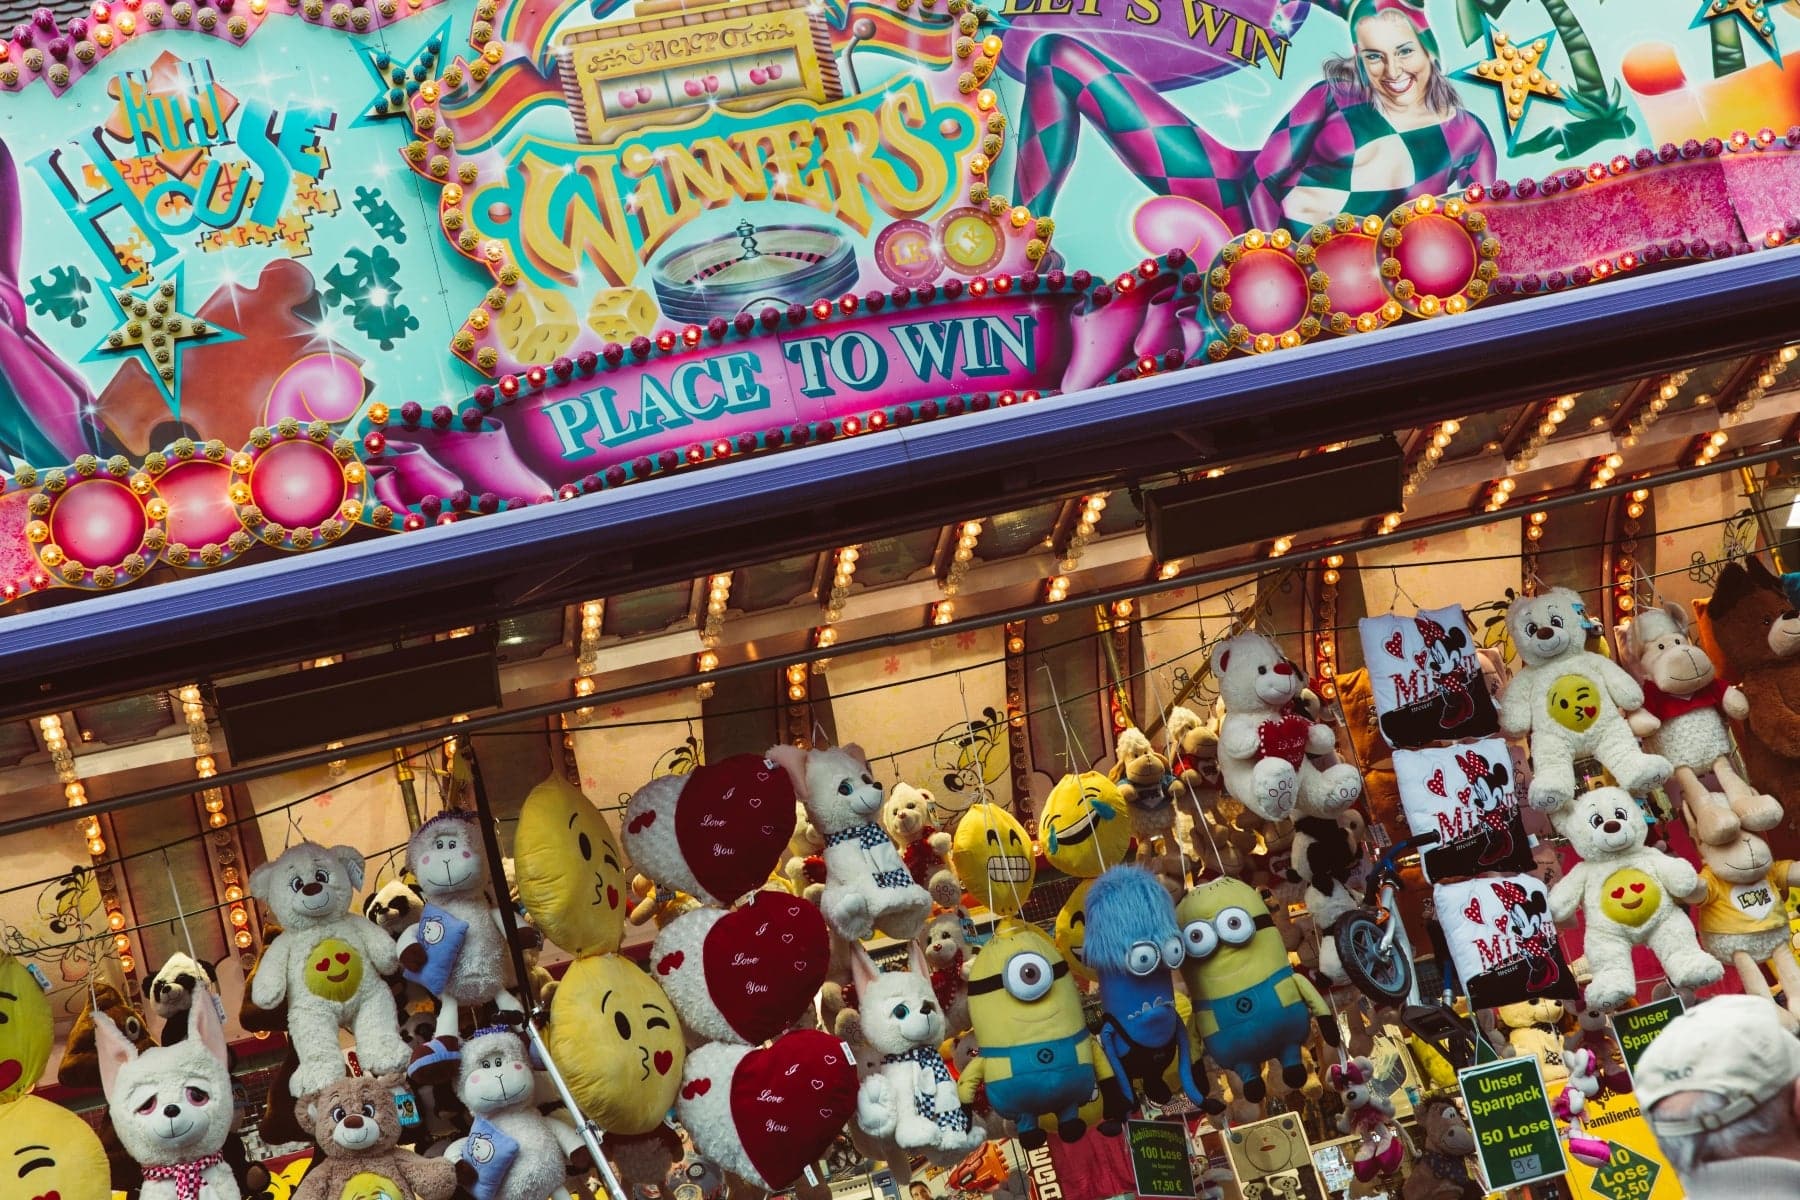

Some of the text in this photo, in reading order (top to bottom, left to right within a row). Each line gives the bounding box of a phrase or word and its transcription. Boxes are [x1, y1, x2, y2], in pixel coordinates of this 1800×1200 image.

[626, 23, 754, 65] JACKPOT
[1178, 0, 1293, 80] WIN
[542, 315, 1038, 460] PLACE TO WIN
[700, 814, 727, 827] Love
[713, 843, 736, 856] You
[731, 952, 760, 966] Love
[745, 980, 768, 995] You
[1628, 1009, 1669, 1030] Unser
[1479, 1072, 1523, 1093] Unser
[756, 1089, 785, 1103] Love
[1471, 1085, 1542, 1116] Sparpack
[765, 1119, 789, 1133] You
[1583, 1106, 1641, 1131] Familienta
[1481, 1128, 1504, 1146] 50
[1507, 1119, 1550, 1139] Lose
[1140, 1146, 1183, 1160] 100 Lose
[1508, 1143, 1533, 1158] nur
[1028, 1141, 1063, 1200] EGA
[1600, 1164, 1649, 1188] Lose
[1613, 1180, 1650, 1200] 2,50
